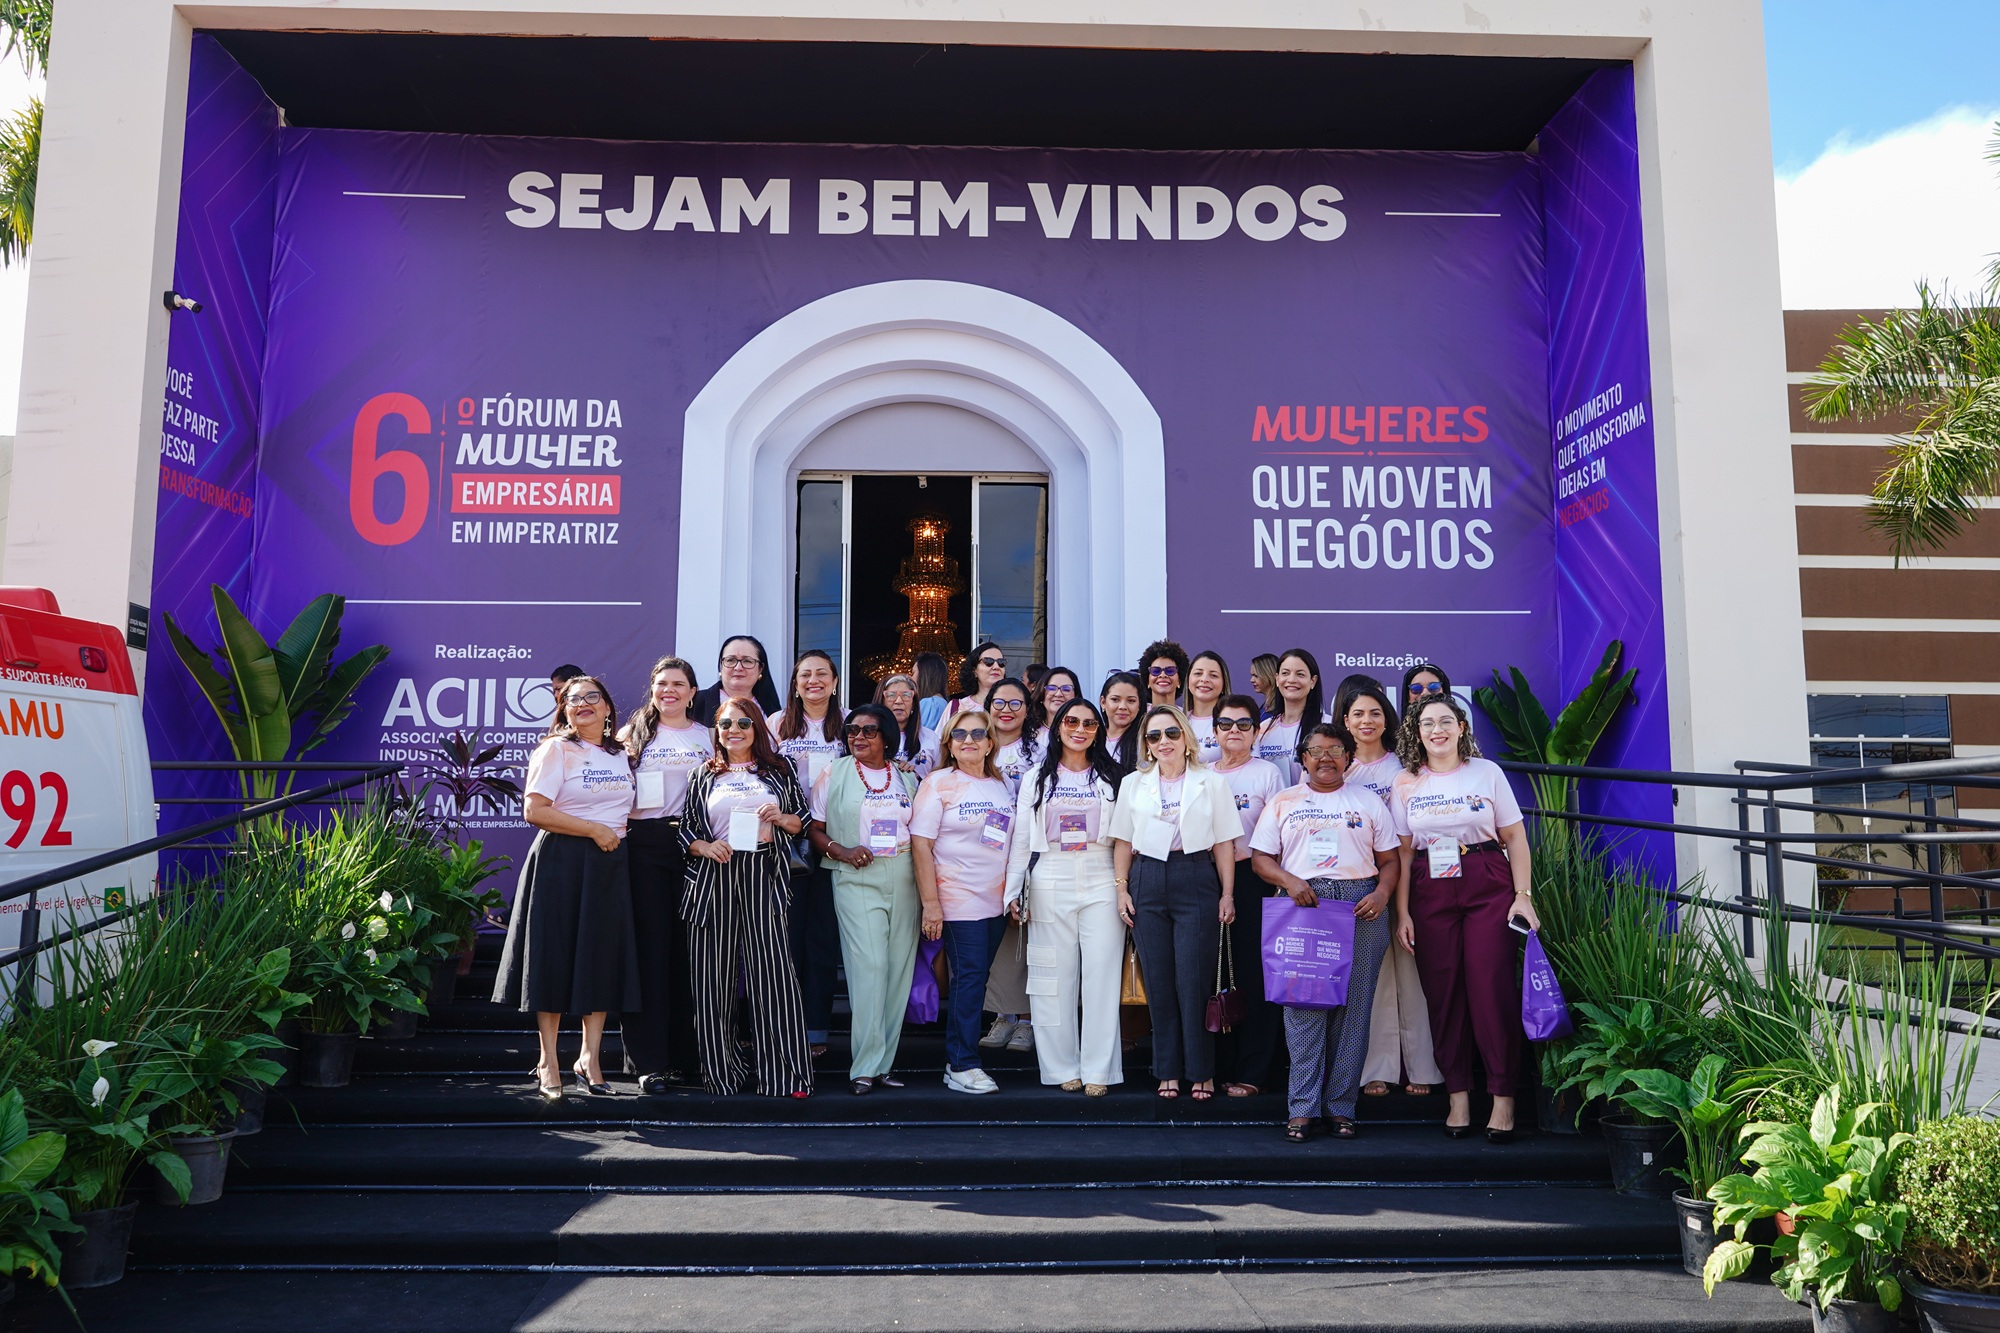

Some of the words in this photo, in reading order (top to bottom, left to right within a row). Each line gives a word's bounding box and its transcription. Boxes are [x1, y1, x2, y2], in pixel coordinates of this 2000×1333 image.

[506, 170, 791, 234] SEJAM
[818, 178, 1348, 242] BEM-VINDOS
[481, 392, 578, 428] FÓRUM
[586, 400, 622, 428] DA
[1556, 419, 1562, 441] O
[1564, 382, 1622, 437] MOVIMENTO
[184, 408, 218, 444] PARTE
[1252, 405, 1489, 446] MULHERES
[1558, 442, 1576, 470] QUE
[1576, 402, 1646, 459] TRANSFORMA
[160, 433, 196, 466] DESSA
[456, 433, 622, 469] MULHER
[350, 392, 432, 546] 6
[1558, 466, 1589, 500] IDEIAS
[1590, 456, 1606, 484] EM
[462, 478, 614, 507] EMPRESÁRIA
[1252, 464, 1331, 510] QUE
[1342, 466, 1492, 509] MOVEM
[1559, 487, 1609, 529] NEGÓCIOS
[452, 521, 482, 543] EM
[488, 521, 619, 544] IMPERATRIZ
[1253, 514, 1494, 570] NEGÓCIOS
[434, 644, 532, 662] Realização:
[1335, 653, 1428, 670] Realização:
[6, 668, 52, 686] SUPORTE
[53, 672, 87, 689] BÁSICO
[381, 678, 496, 728] ACII
[484, 732, 547, 744] COMERC
[380, 749, 474, 762] INDUSTR
[494, 749, 534, 762] SERV
[423, 766, 529, 778] IMPERAT
[584, 774, 628, 784] Empresarial
[434, 795, 522, 816] MULHE
[1411, 797, 1465, 811] Empresarial
[1415, 804, 1464, 819] Mulher
[1290, 813, 1343, 823] Empresarial
[55, 897, 64, 909] de
[1275, 936, 1284, 955] 6
[1530, 972, 1543, 991] 6
